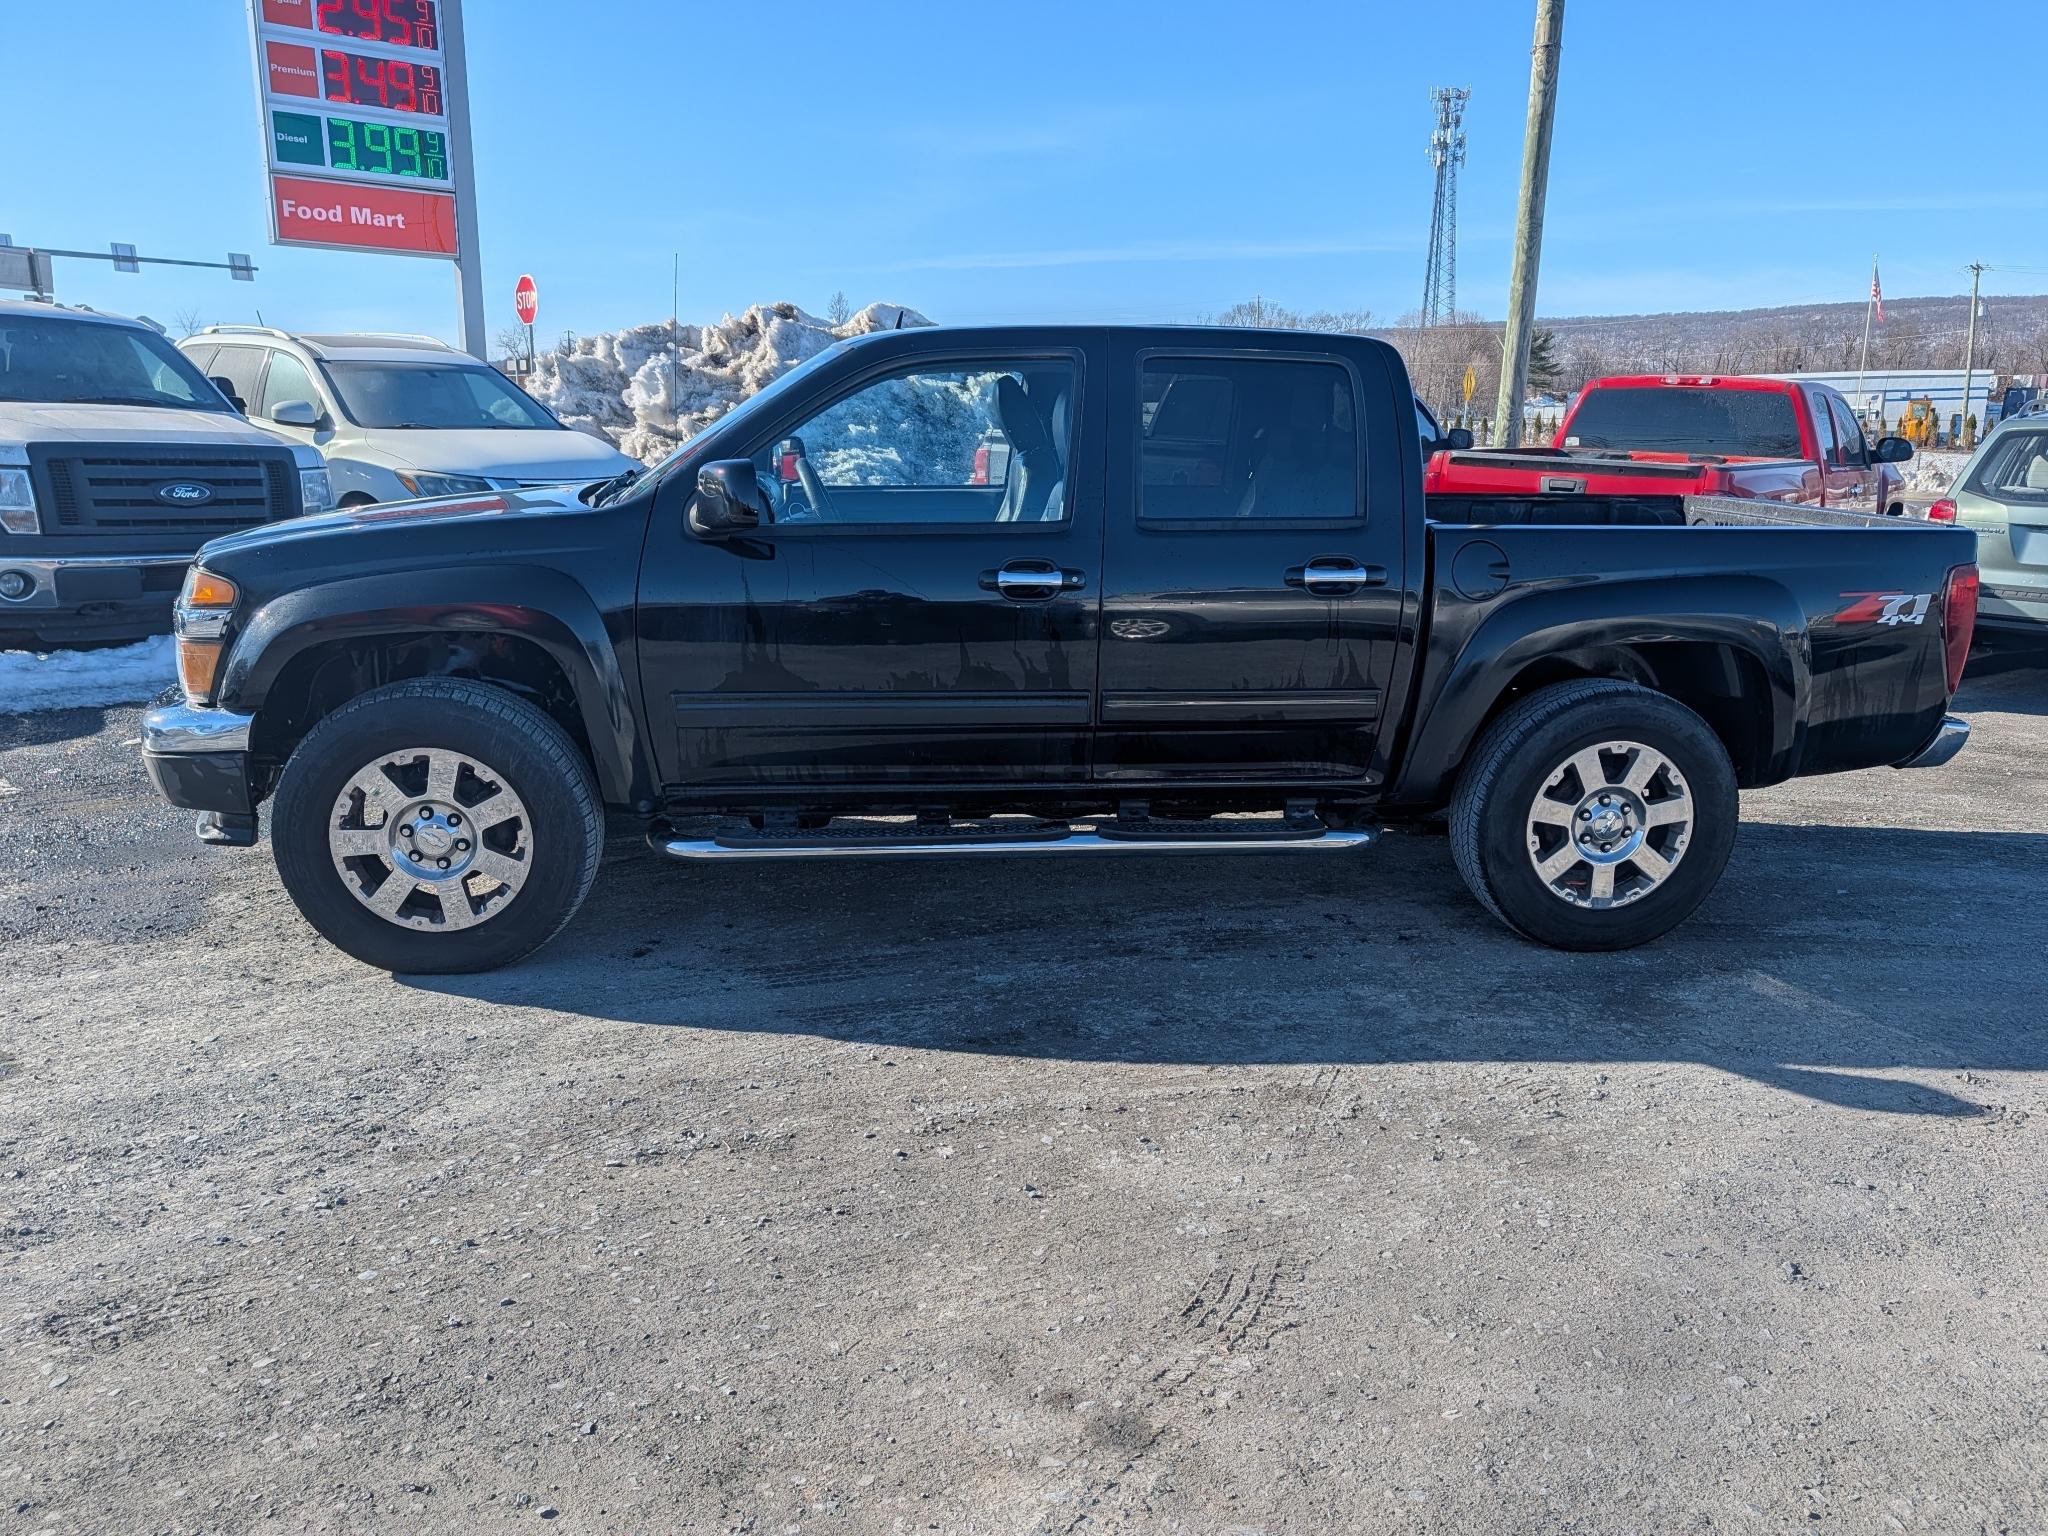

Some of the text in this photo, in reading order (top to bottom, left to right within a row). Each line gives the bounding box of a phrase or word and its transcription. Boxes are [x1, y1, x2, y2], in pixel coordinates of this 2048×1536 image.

[318, 0, 412, 46] 2.95
[270, 63, 316, 77] Premium
[323, 49, 417, 112] 3.49
[276, 132, 308, 144] Diesel
[329, 118, 422, 177] 3.99
[282, 199, 406, 229] Food Mart
[517, 291, 536, 310] STOP
[173, 486, 200, 498] Ford
[1833, 590, 1932, 623] Z71
